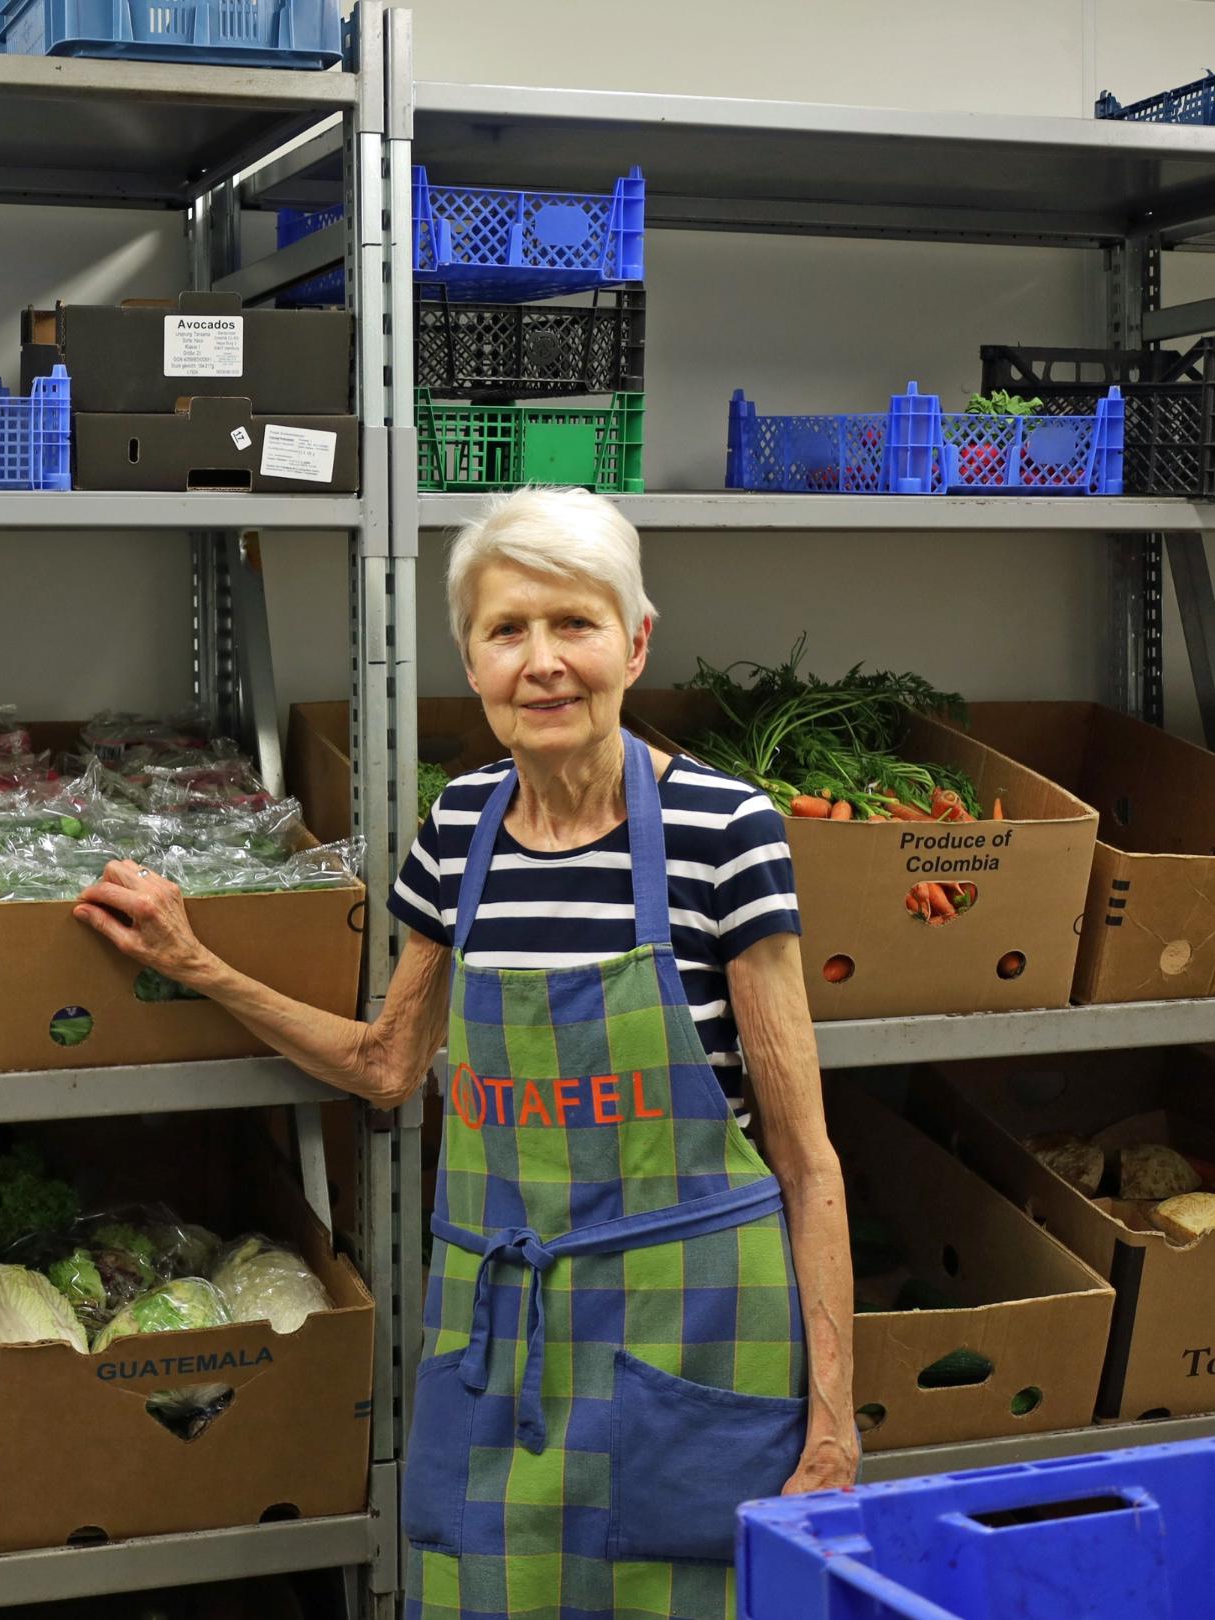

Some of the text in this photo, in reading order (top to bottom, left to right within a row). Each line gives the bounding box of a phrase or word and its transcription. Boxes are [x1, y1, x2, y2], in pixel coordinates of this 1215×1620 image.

[177, 319, 236, 330] Avocados
[900, 829, 1013, 850] Produce of
[906, 854, 1000, 873] Colombia
[482, 1071, 664, 1127] TAFEL
[96, 1347, 274, 1381] GUATEMALA
